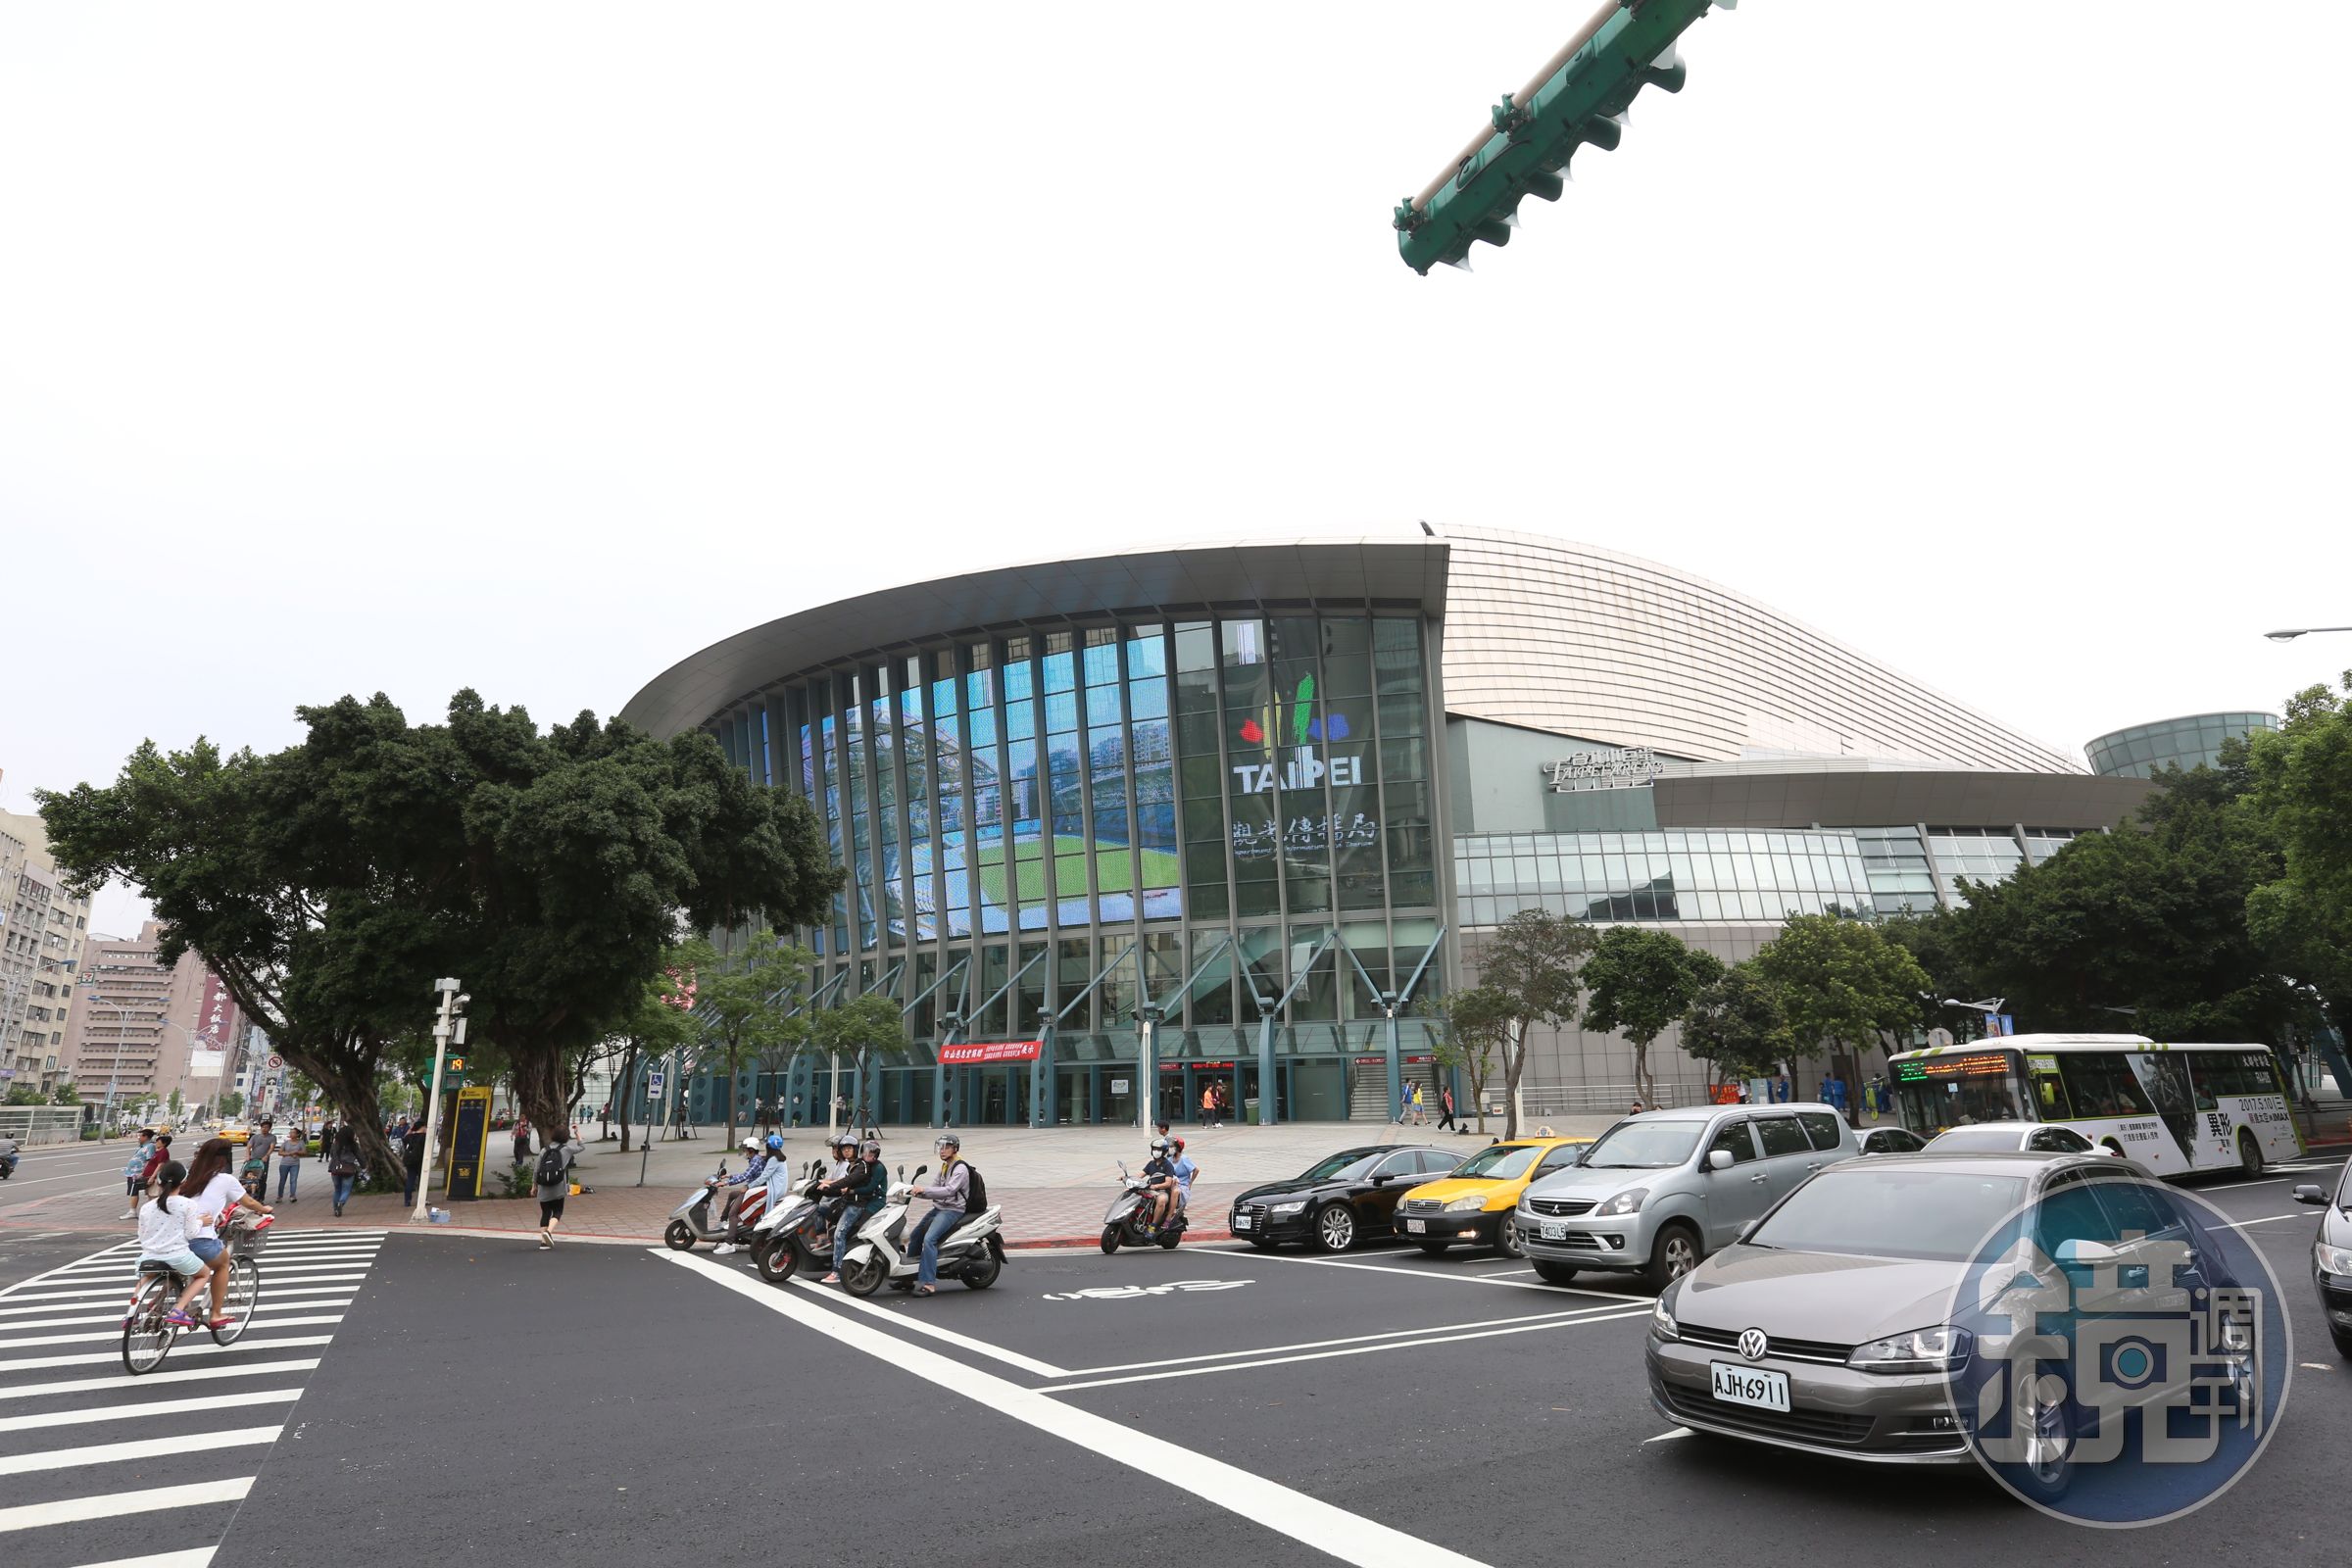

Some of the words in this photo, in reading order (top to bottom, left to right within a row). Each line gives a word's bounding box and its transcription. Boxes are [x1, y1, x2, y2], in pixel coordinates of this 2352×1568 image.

[1233, 746, 1362, 794] TAIPEI
[1544, 760, 1608, 785] TAIPEI
[1608, 760, 1666, 777] ARENA
[451, 1058, 463, 1070] 19
[2207, 1113, 2232, 1137] 異形
[1714, 1372, 1785, 1405] AJH-6911
